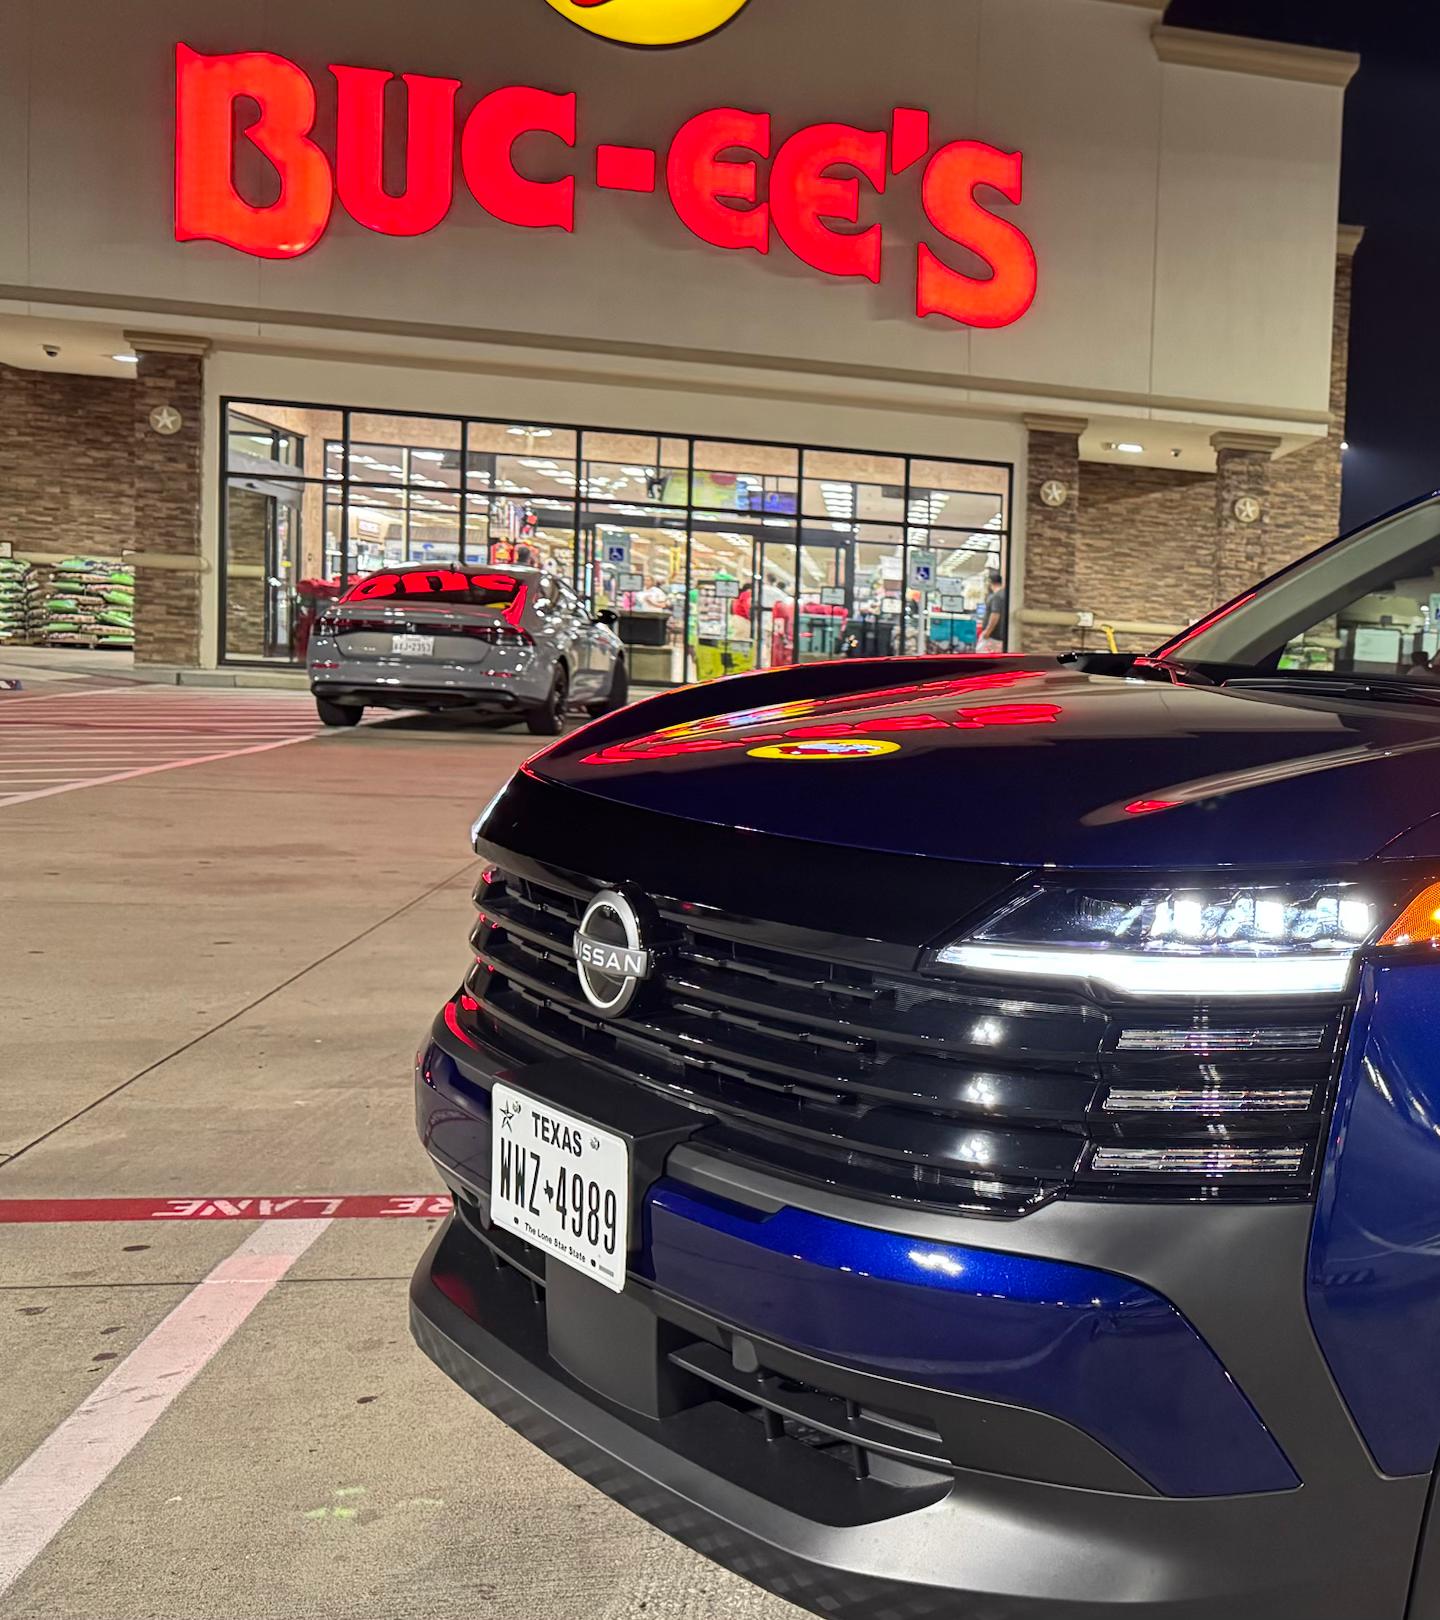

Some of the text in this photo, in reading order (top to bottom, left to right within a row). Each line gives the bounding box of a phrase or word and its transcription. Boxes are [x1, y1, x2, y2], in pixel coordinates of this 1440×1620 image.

[176, 42, 1038, 329] BUC-EE'S
[573, 934, 641, 973] NISSAN
[531, 1111, 582, 1158] TEXAS
[151, 1197, 454, 1217] RE LANE
[524, 1222, 586, 1262] The Lone Star State
